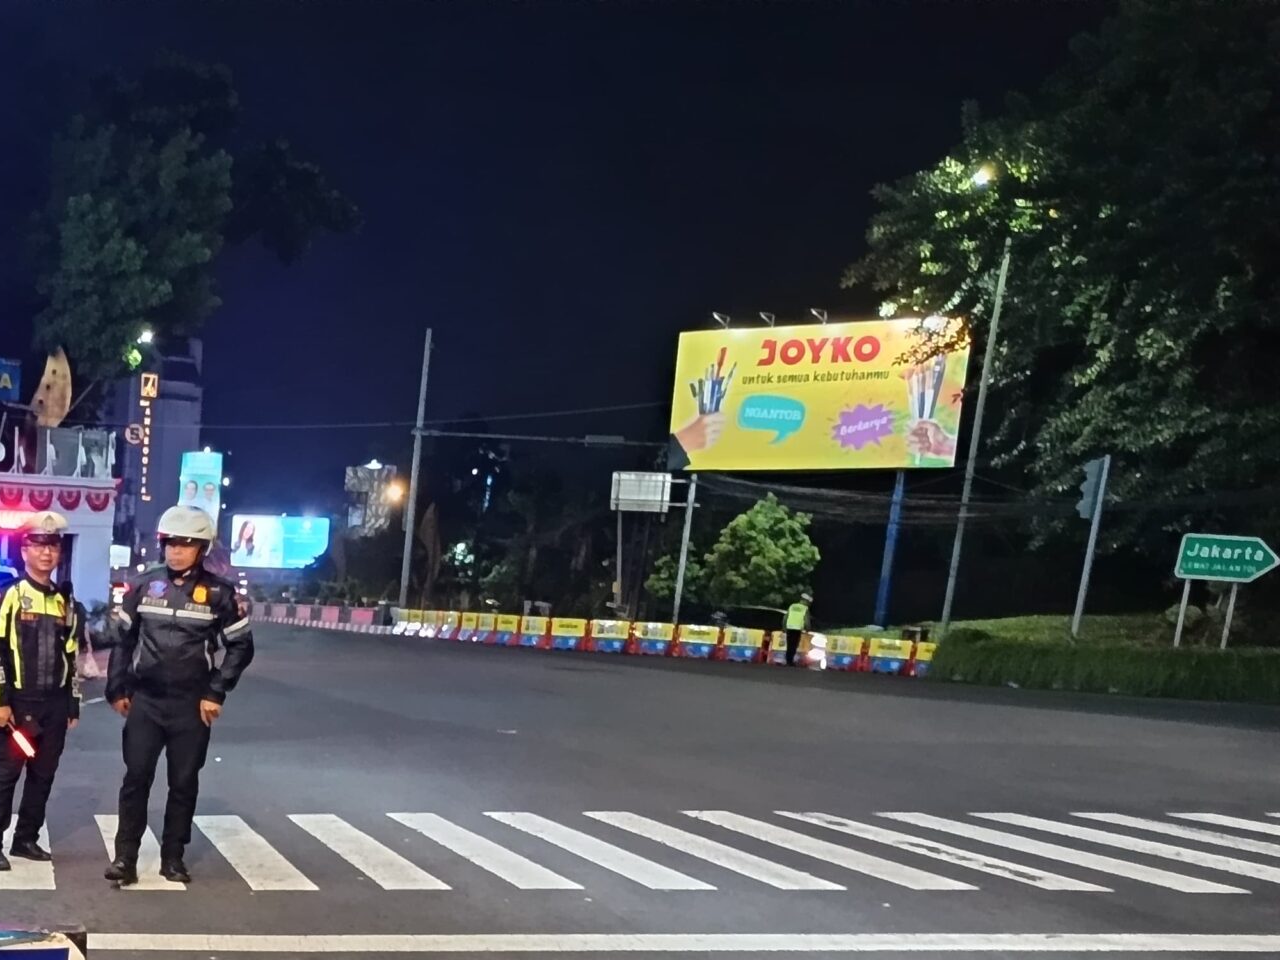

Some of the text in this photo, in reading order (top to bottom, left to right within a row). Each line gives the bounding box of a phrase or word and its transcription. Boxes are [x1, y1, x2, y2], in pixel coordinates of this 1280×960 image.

[757, 336, 880, 366] JOYKO
[742, 370, 889, 385] untuk semua kebutuhanmu
[1187, 543, 1264, 561] Jakarta
